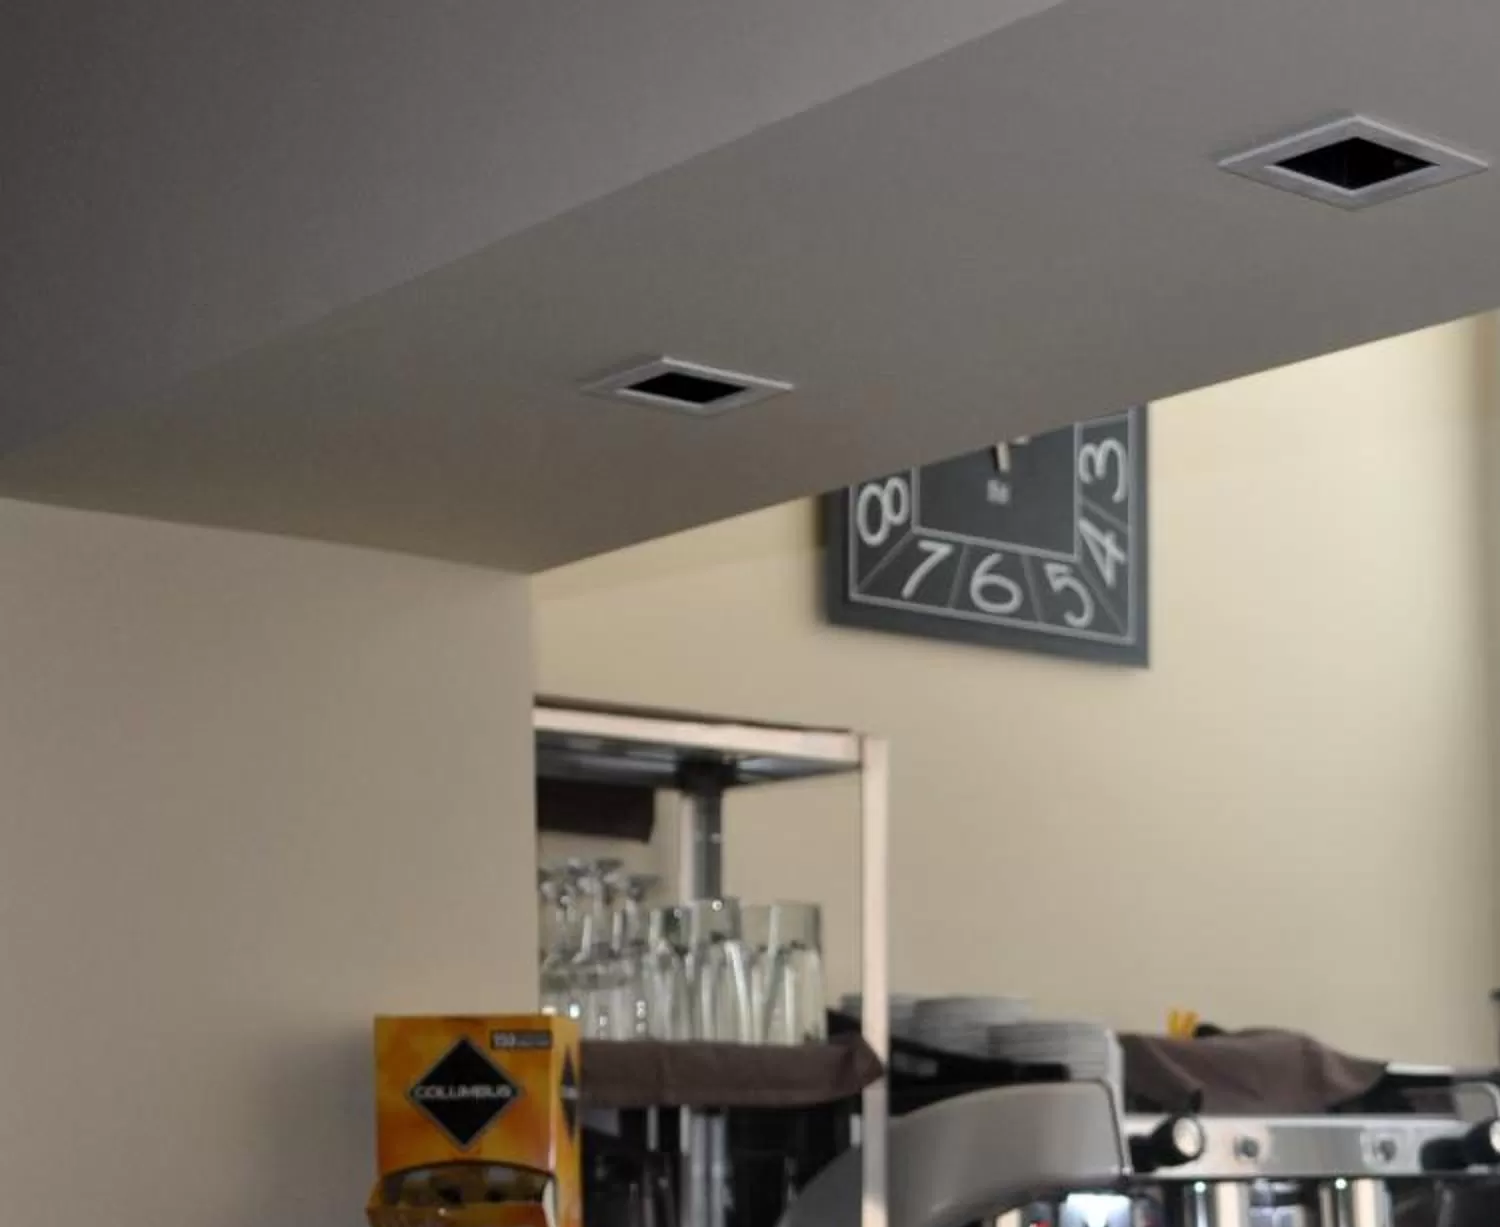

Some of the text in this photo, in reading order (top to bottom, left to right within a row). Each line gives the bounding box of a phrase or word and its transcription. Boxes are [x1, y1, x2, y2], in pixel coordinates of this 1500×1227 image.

[1078, 437, 1128, 503] 3
[857, 476, 910, 546] 8
[901, 539, 952, 599] 7
[969, 552, 1024, 614] 6
[1079, 516, 1128, 588] 4
[1043, 561, 1095, 628] 5
